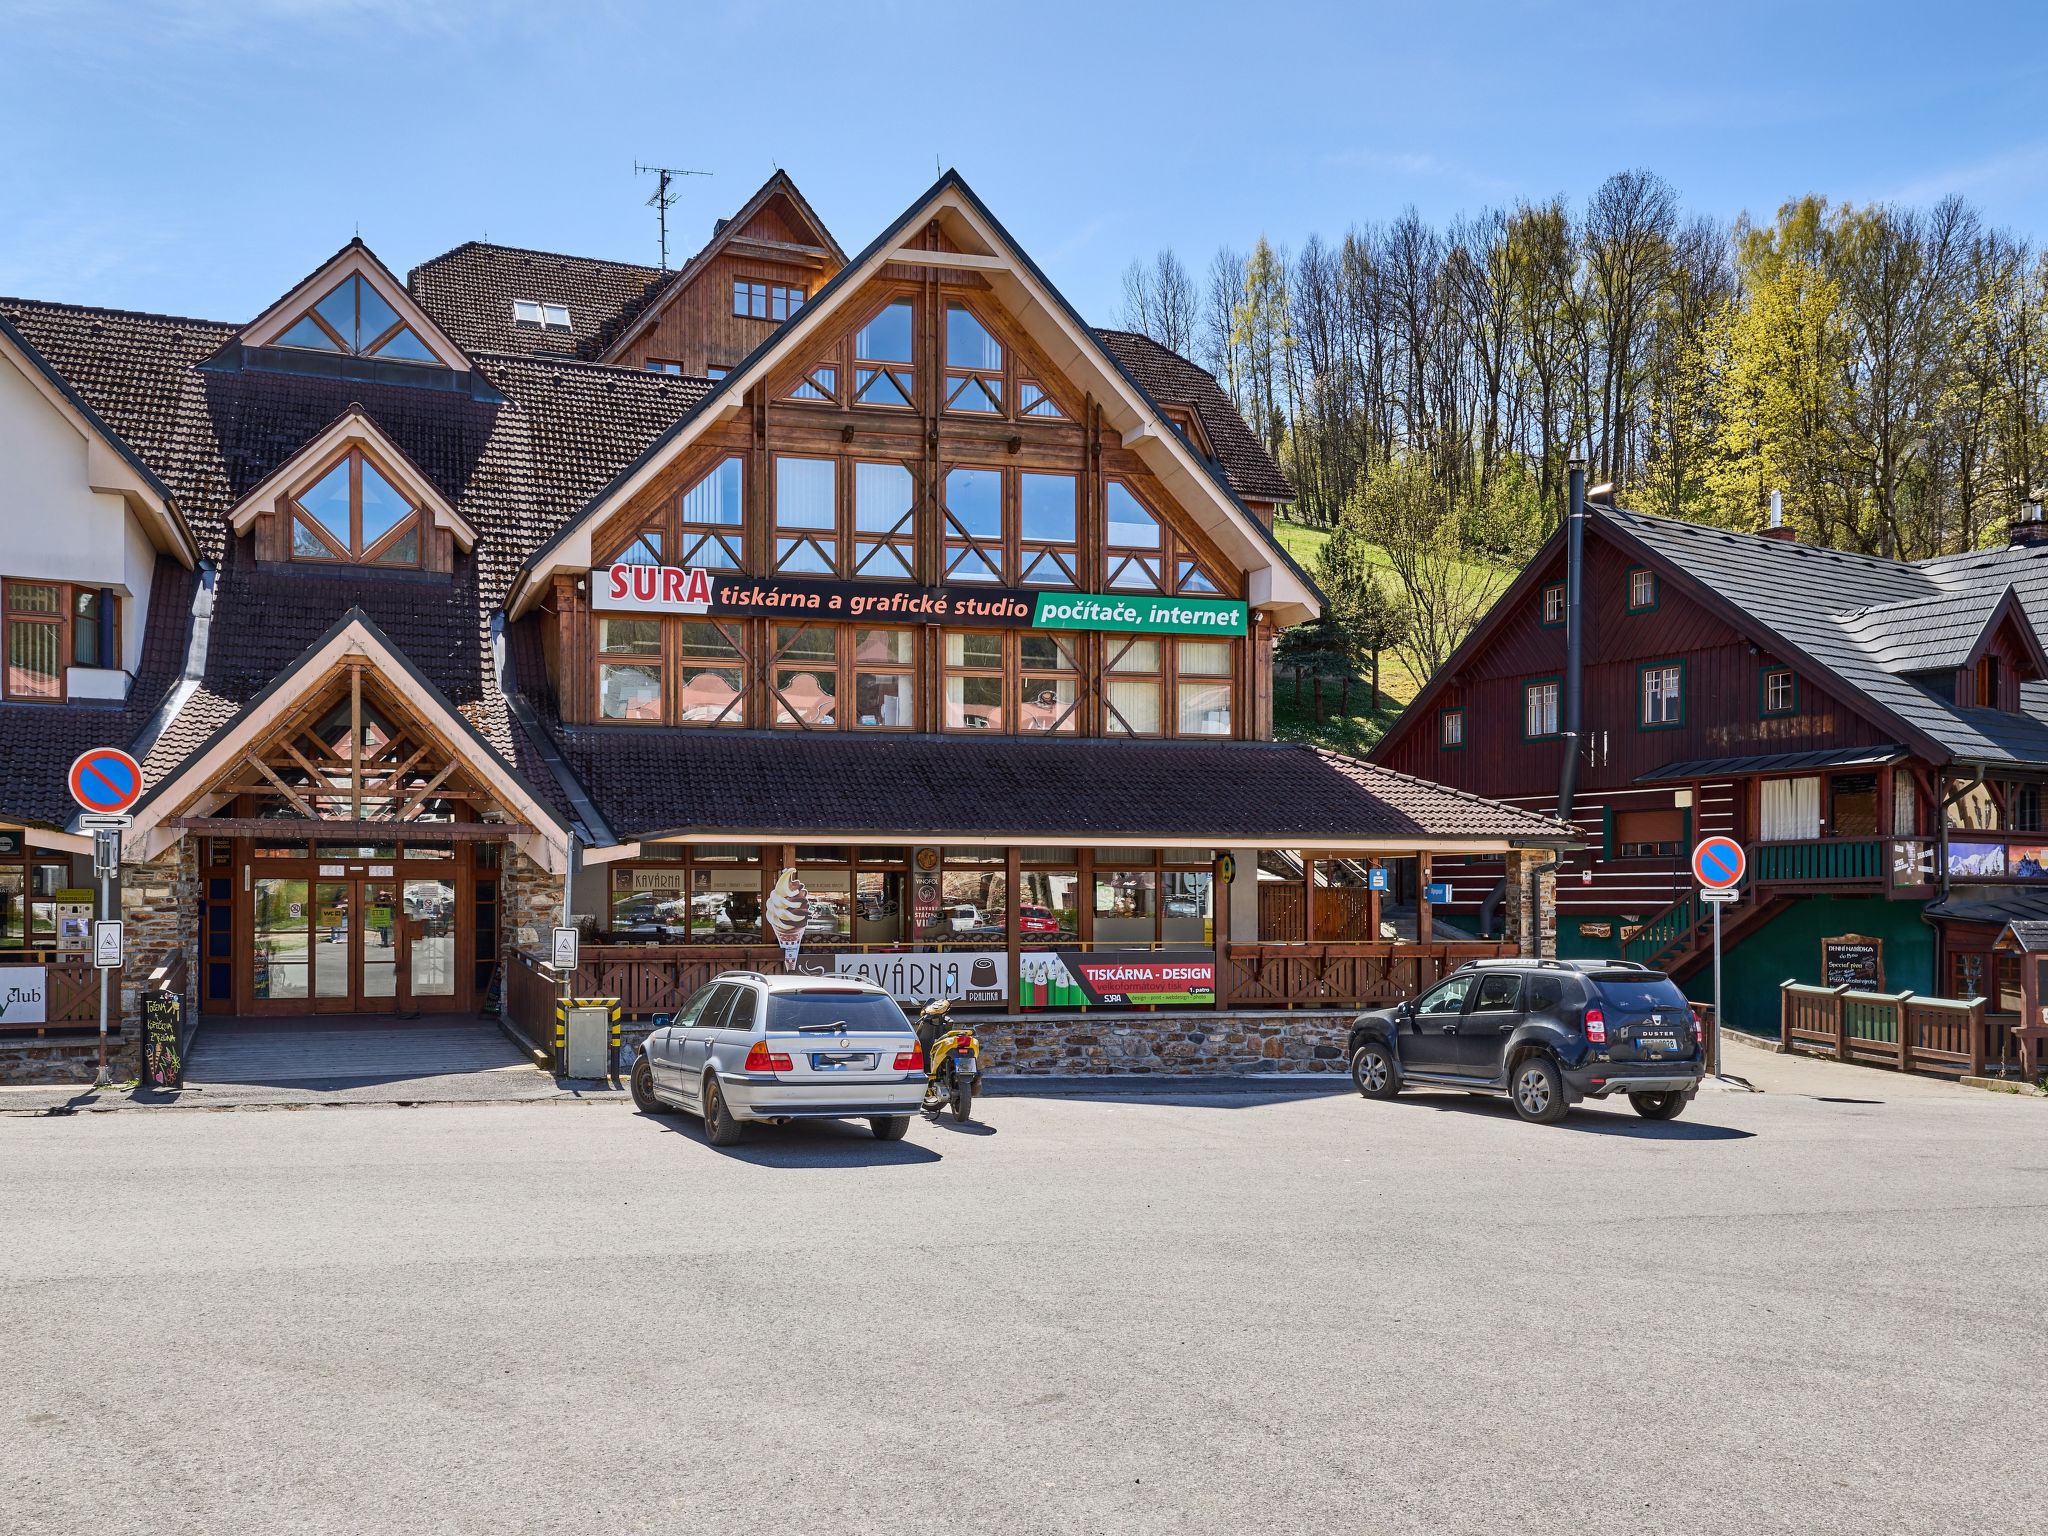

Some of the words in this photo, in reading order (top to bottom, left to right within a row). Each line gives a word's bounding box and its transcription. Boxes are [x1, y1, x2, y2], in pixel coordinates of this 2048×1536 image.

[608, 563, 713, 606] SURA
[720, 586, 820, 608] tiskárna
[828, 595, 842, 609] a
[849, 593, 948, 615] grafické
[954, 598, 1028, 617] studio
[1040, 600, 1142, 625] počítače,
[1149, 605, 1240, 626] internet
[635, 873, 681, 888] KAVÁRNA
[1086, 966, 1154, 981] TISKÁRNA
[1162, 968, 1211, 980] DESIGN
[1097, 982, 1165, 992] velkoformátový
[1167, 981, 1183, 990] tisk
[7, 988, 41, 1003] club
[969, 991, 999, 1001] PRALINKA
